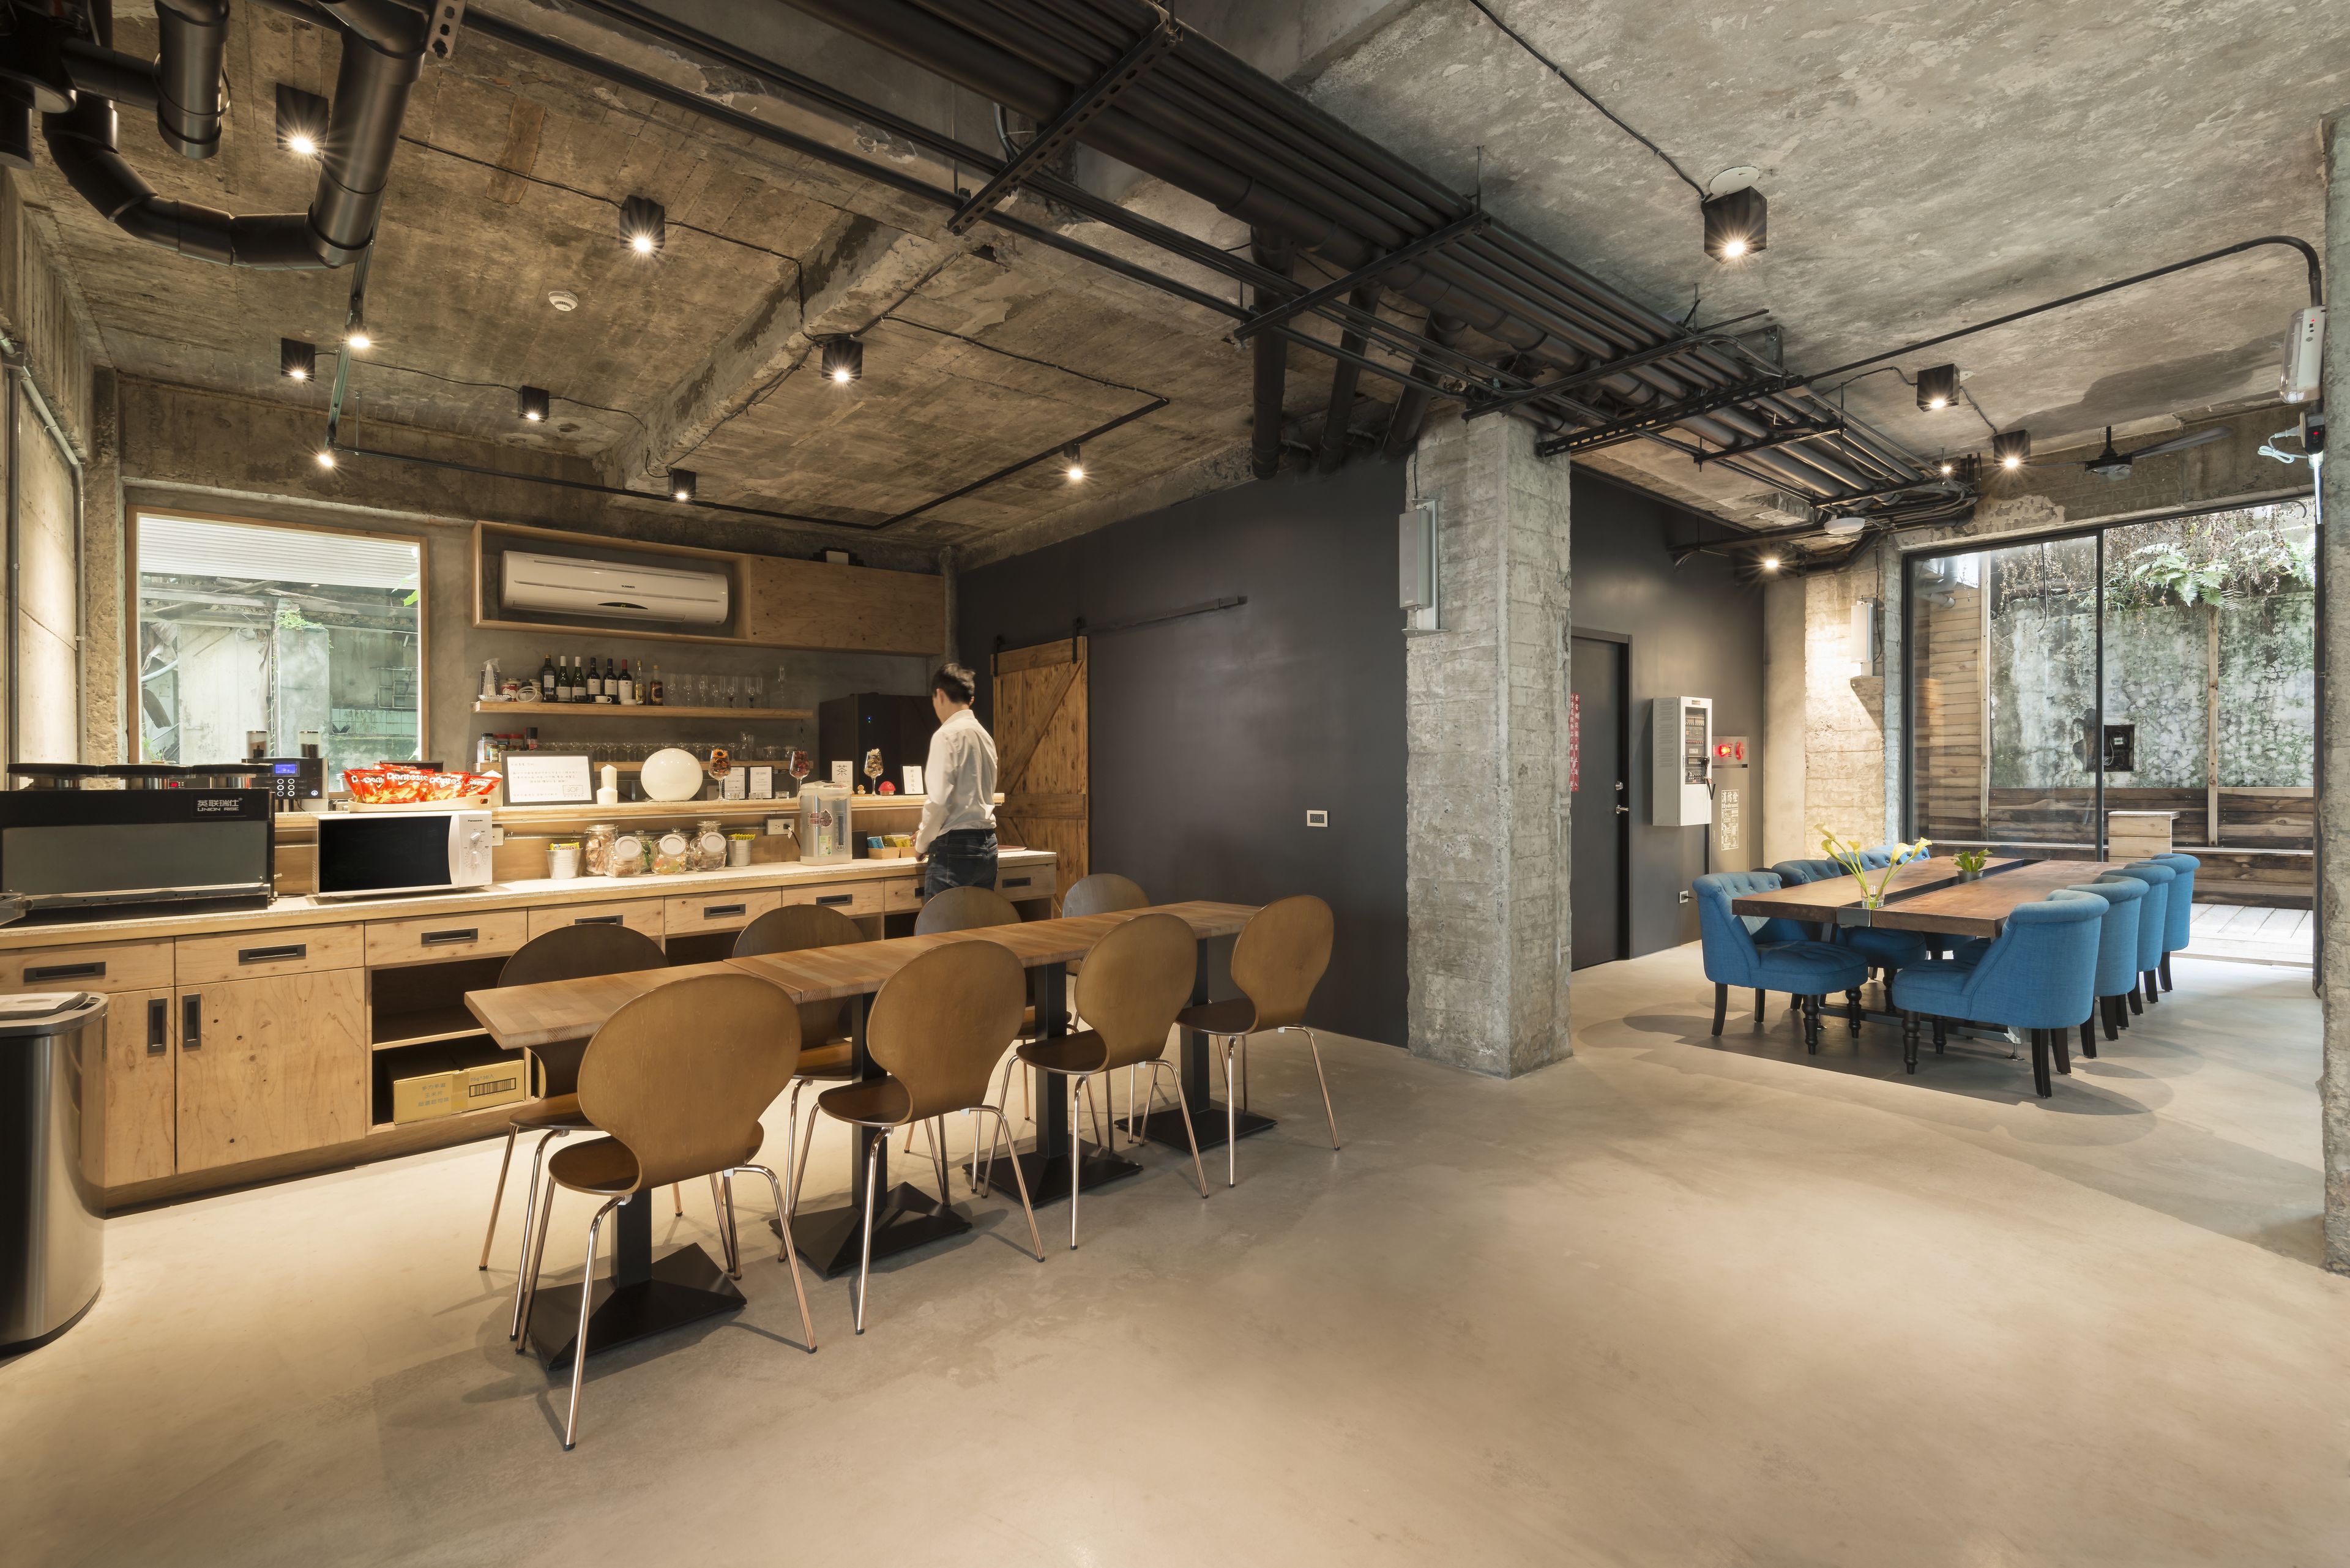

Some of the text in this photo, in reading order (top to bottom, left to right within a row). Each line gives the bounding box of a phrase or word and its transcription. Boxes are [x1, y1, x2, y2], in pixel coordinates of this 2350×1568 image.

[837, 764, 848, 776] 茶
[386, 772, 421, 781] Doritos
[429, 775, 461, 784] Doritos
[1721, 791, 1738, 803] 消防栓
